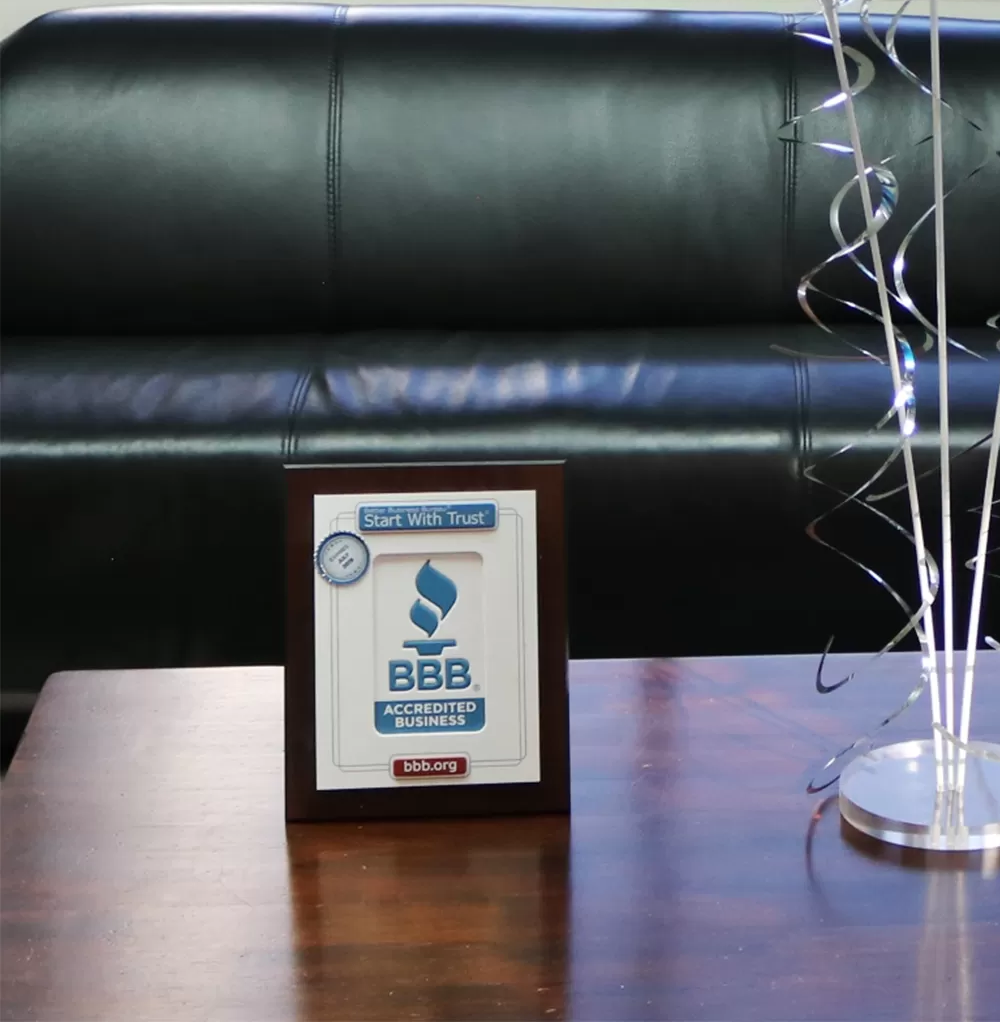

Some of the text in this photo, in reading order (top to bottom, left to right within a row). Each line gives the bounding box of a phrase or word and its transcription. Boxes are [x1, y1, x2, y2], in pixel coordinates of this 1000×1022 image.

[364, 511, 485, 528] Start With Trust
[389, 658, 471, 692] BBB
[383, 701, 477, 716] ACCREDITED
[395, 714, 466, 728] BUSINESS
[403, 759, 458, 773] bbb.org
